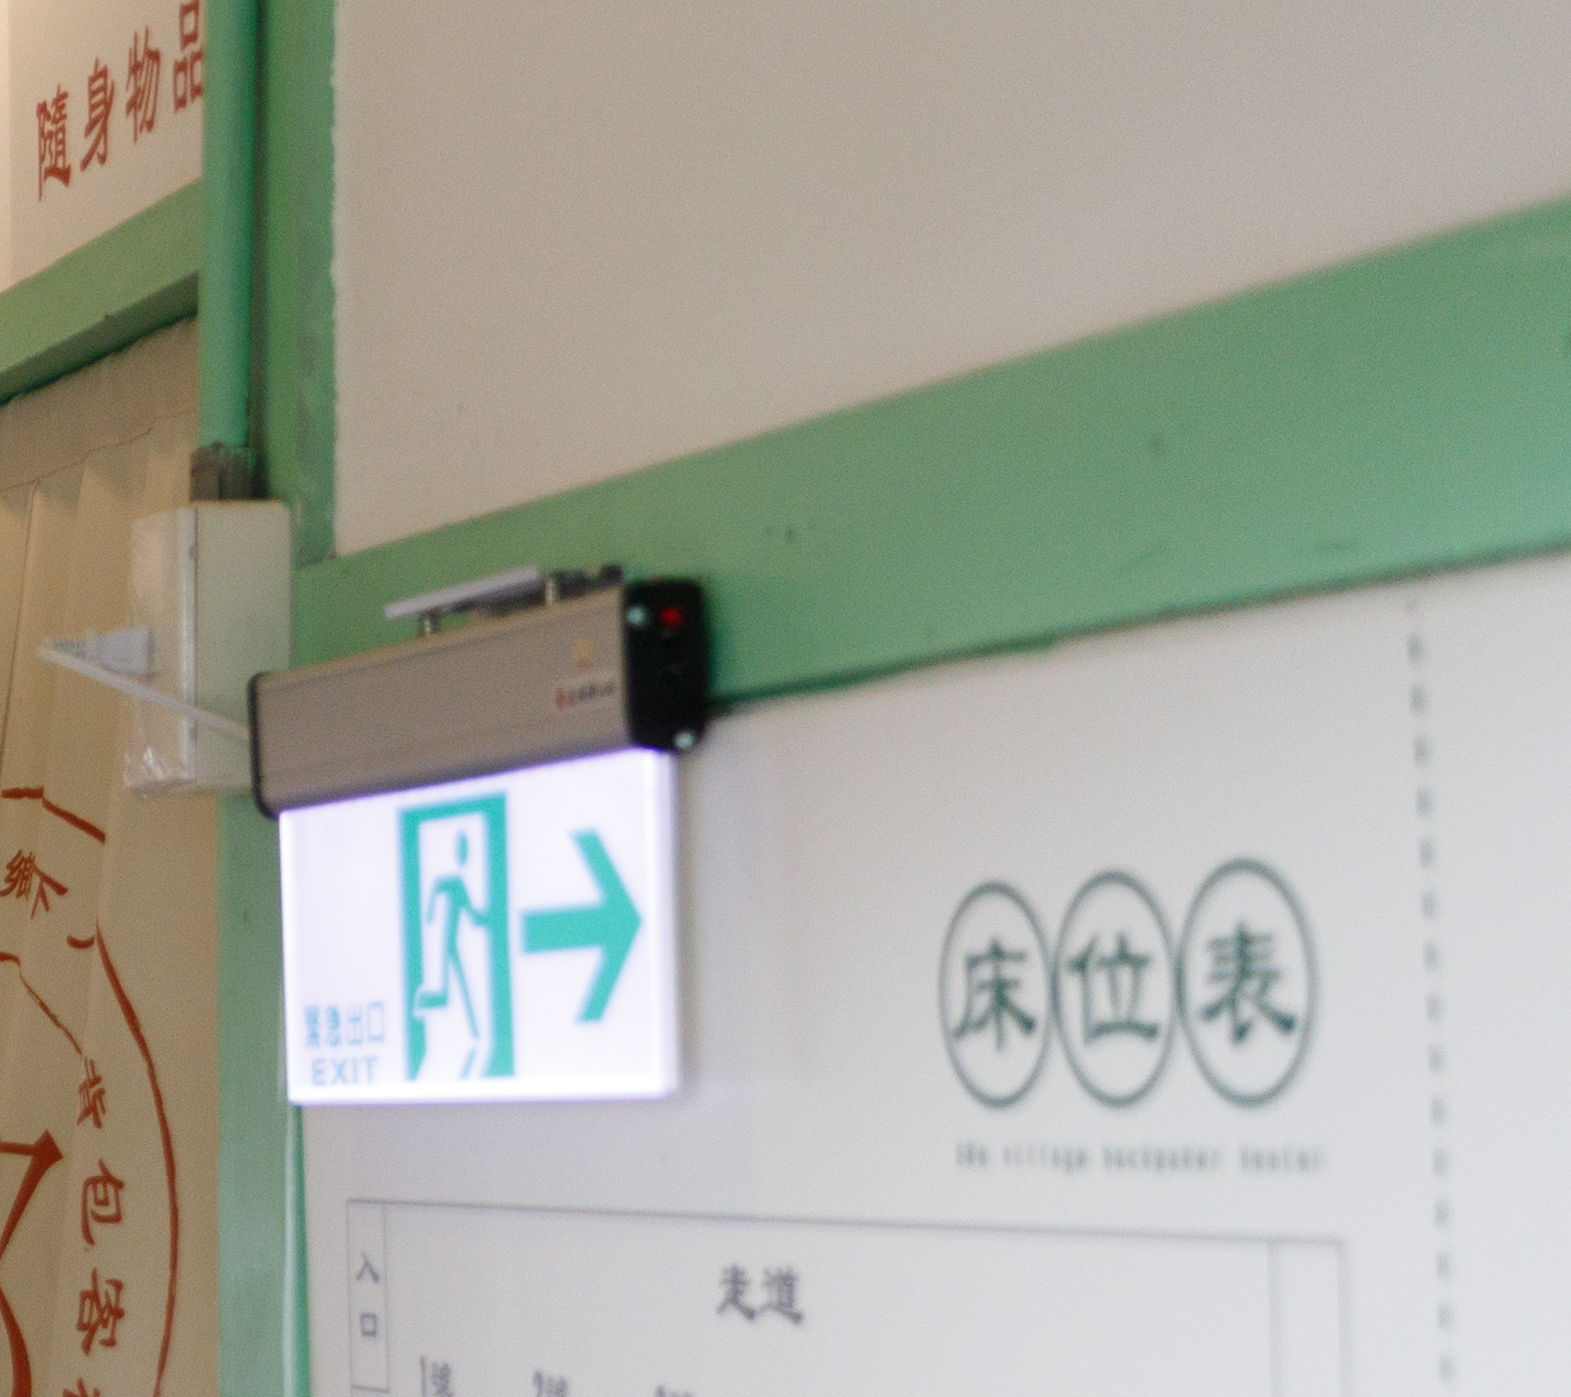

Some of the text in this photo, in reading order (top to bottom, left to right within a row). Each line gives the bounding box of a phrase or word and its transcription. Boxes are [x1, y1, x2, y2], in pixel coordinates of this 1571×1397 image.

[952, 920, 1299, 1052] 床位表
[304, 1001, 387, 1050] 緊急出口
[311, 1056, 382, 1087] EXIT
[355, 1251, 382, 1341] 入口
[717, 1264, 806, 1326] 走道
